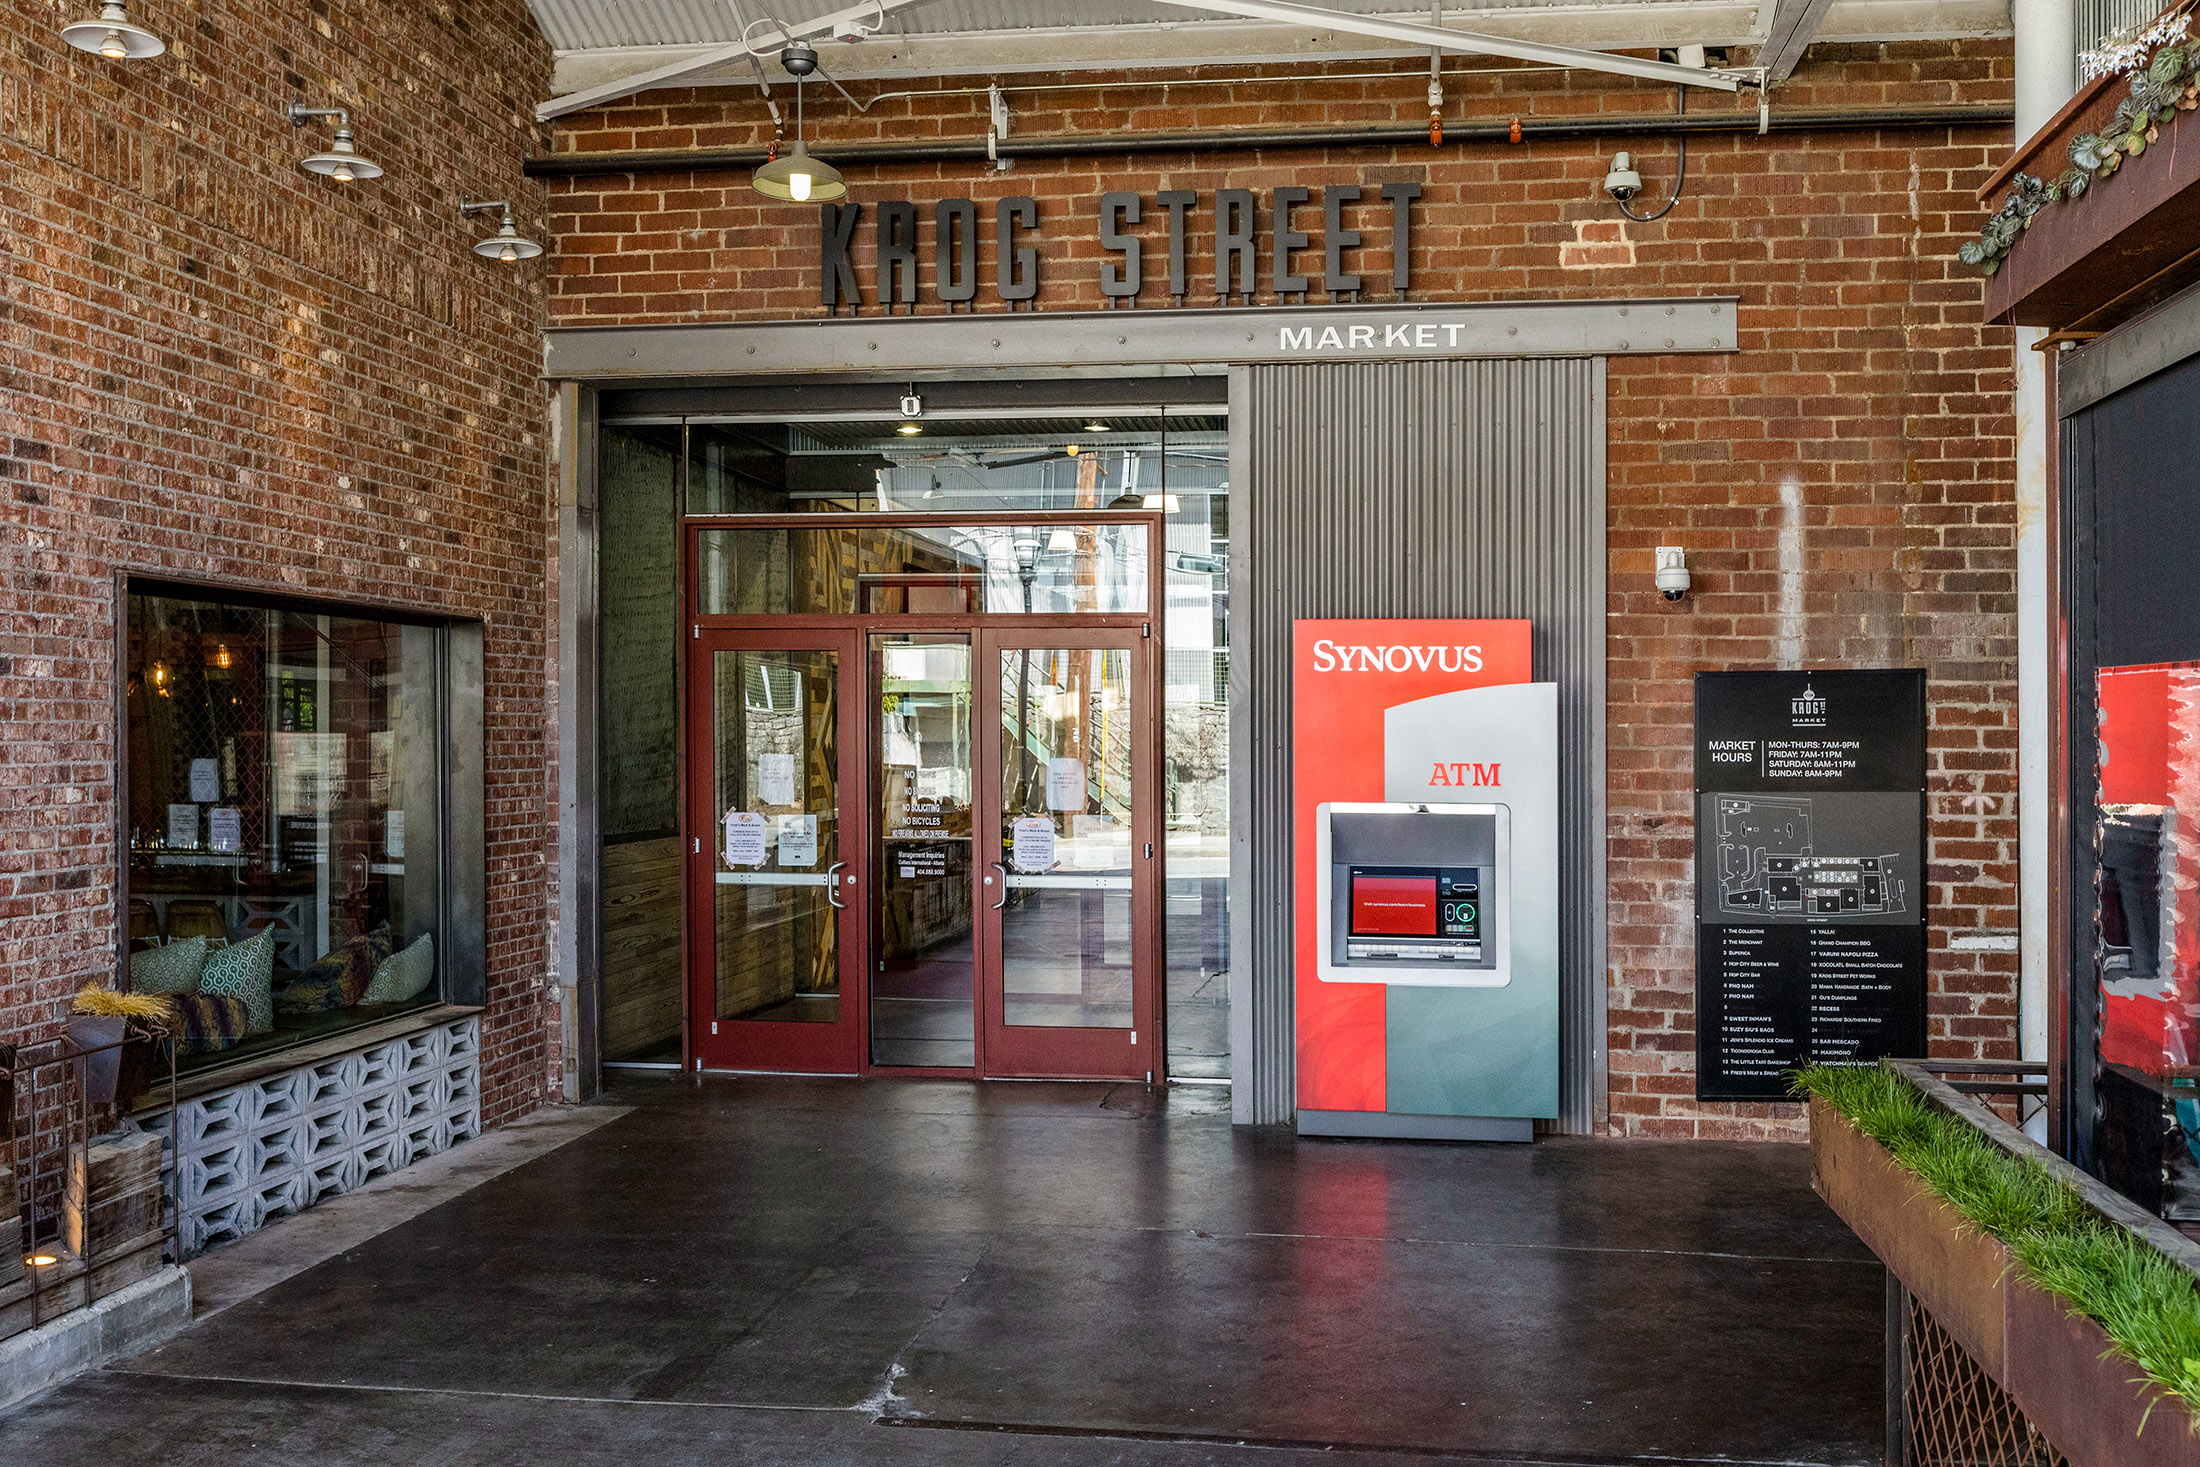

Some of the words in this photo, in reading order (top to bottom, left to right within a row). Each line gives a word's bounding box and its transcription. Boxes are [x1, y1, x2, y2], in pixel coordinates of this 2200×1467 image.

[821, 196, 1038, 305] KROG
[1100, 182, 1422, 297] STREET
[1280, 323, 1466, 350] MARKET
[1313, 640, 1483, 672] SYNOVUS
[1792, 702, 1818, 714] KROG
[1708, 741, 1756, 750] MARKET
[1768, 741, 1820, 749] MON-THURS:
[1822, 741, 1860, 749] 7AM-9PM
[1712, 753, 1752, 762] HOURS
[904, 770, 915, 779] NO
[1429, 763, 1501, 786] ATM
[904, 787, 912, 796] NO
[902, 803, 910, 812] NO
[902, 817, 911, 825] NO
[912, 817, 940, 825] BICYCLES
[898, 851, 925, 859] Management
[926, 852, 945, 860] Inquiries
